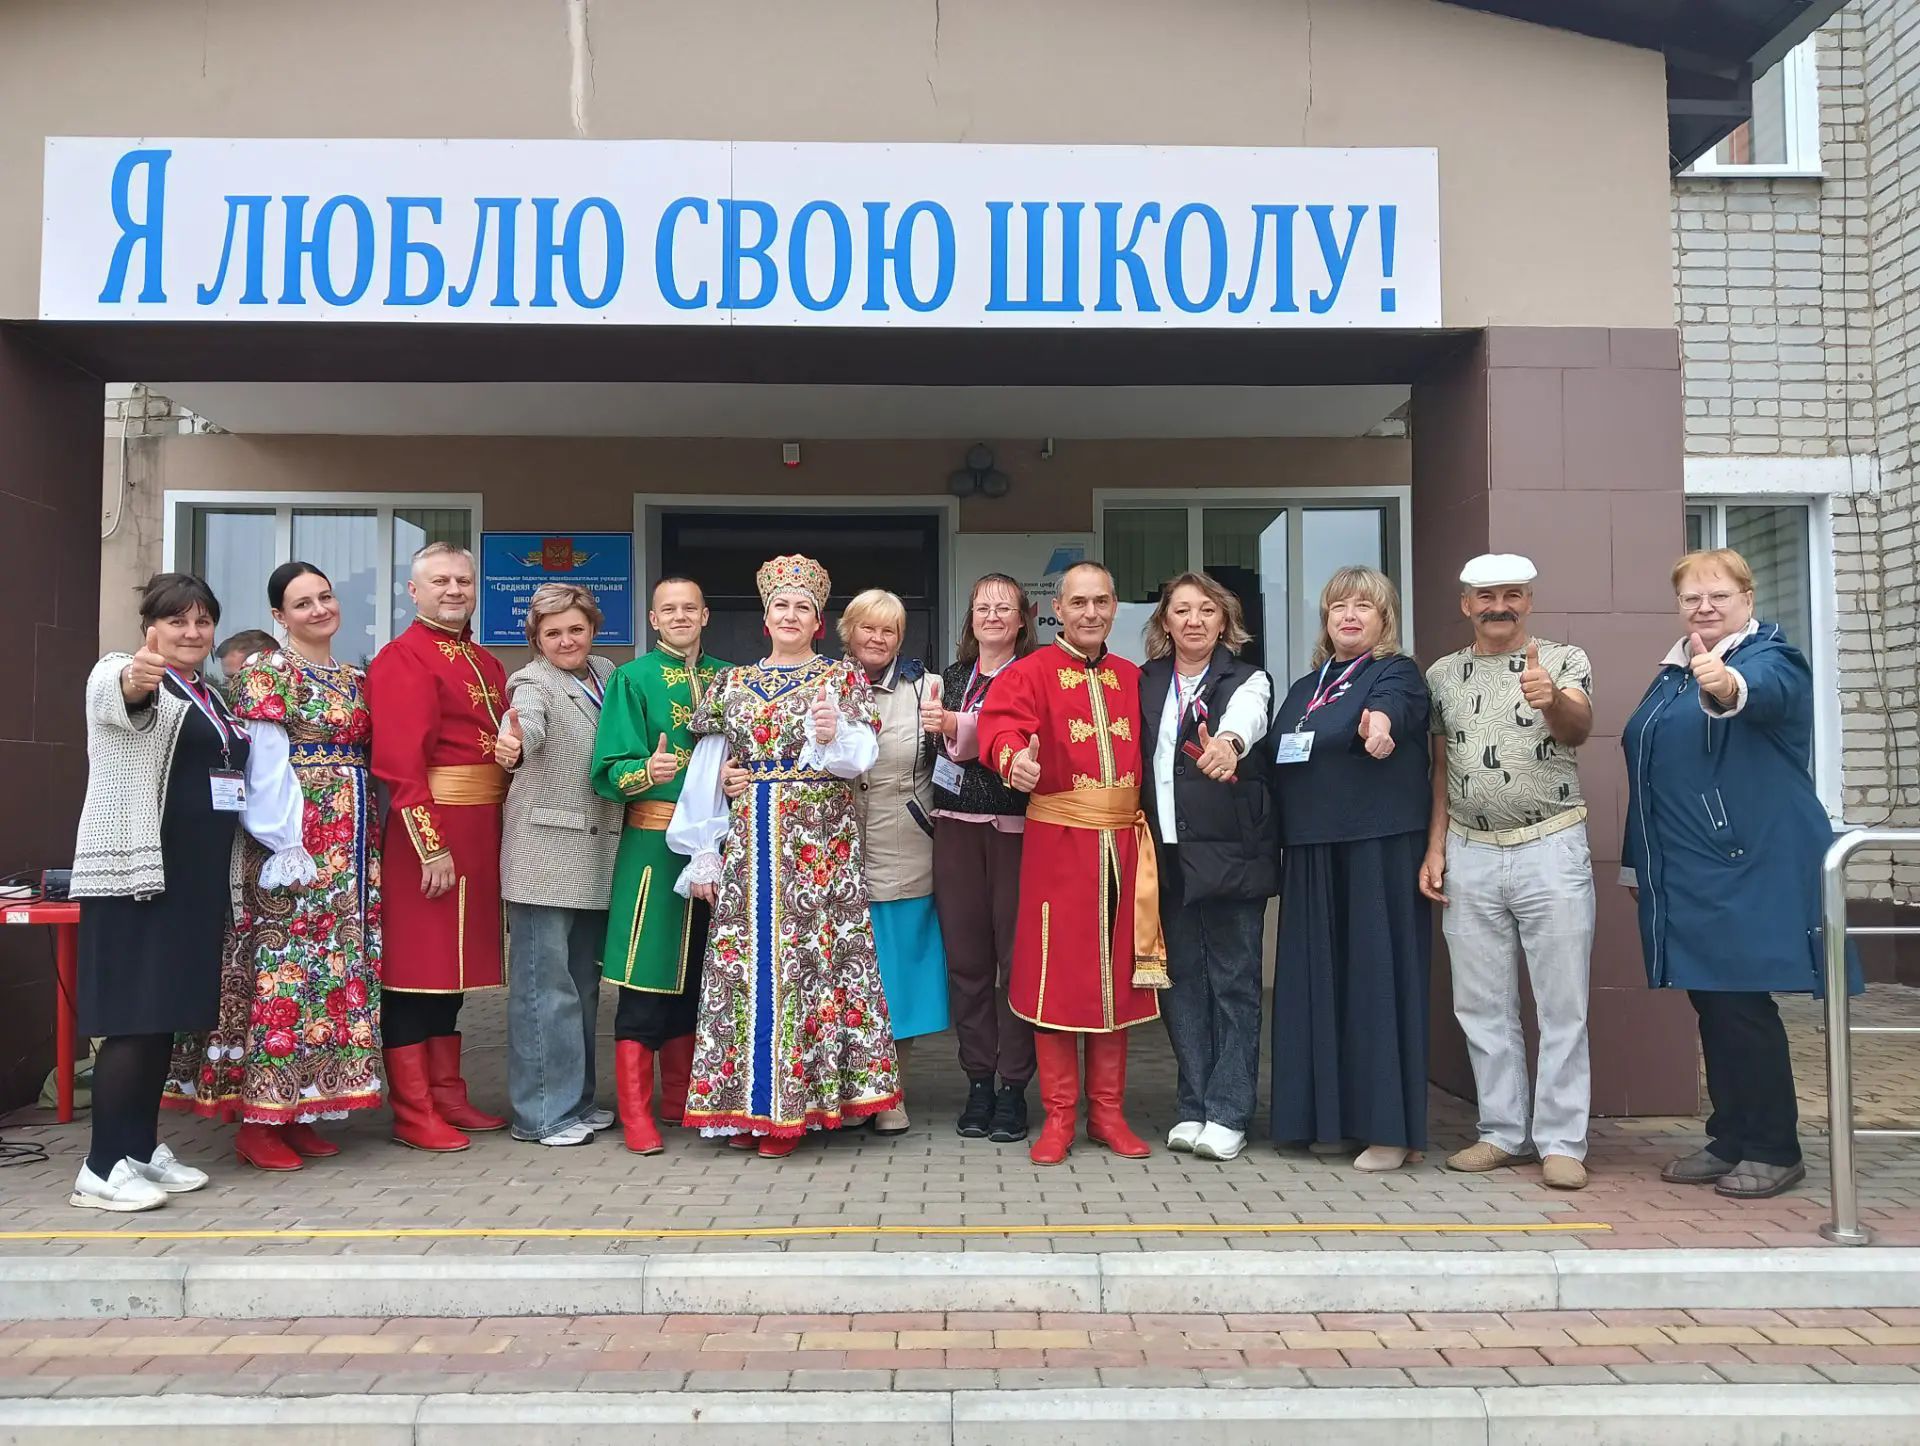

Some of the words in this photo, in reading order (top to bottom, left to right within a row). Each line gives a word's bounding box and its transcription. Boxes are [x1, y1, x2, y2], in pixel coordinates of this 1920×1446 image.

[97, 149, 172, 305] Я
[197, 195, 625, 309] ЛЮБЛЮ
[656, 197, 957, 312] СВОЮ
[985, 201, 1398, 315] ШКОЛУ!
[491, 582, 530, 592] «Средняя
